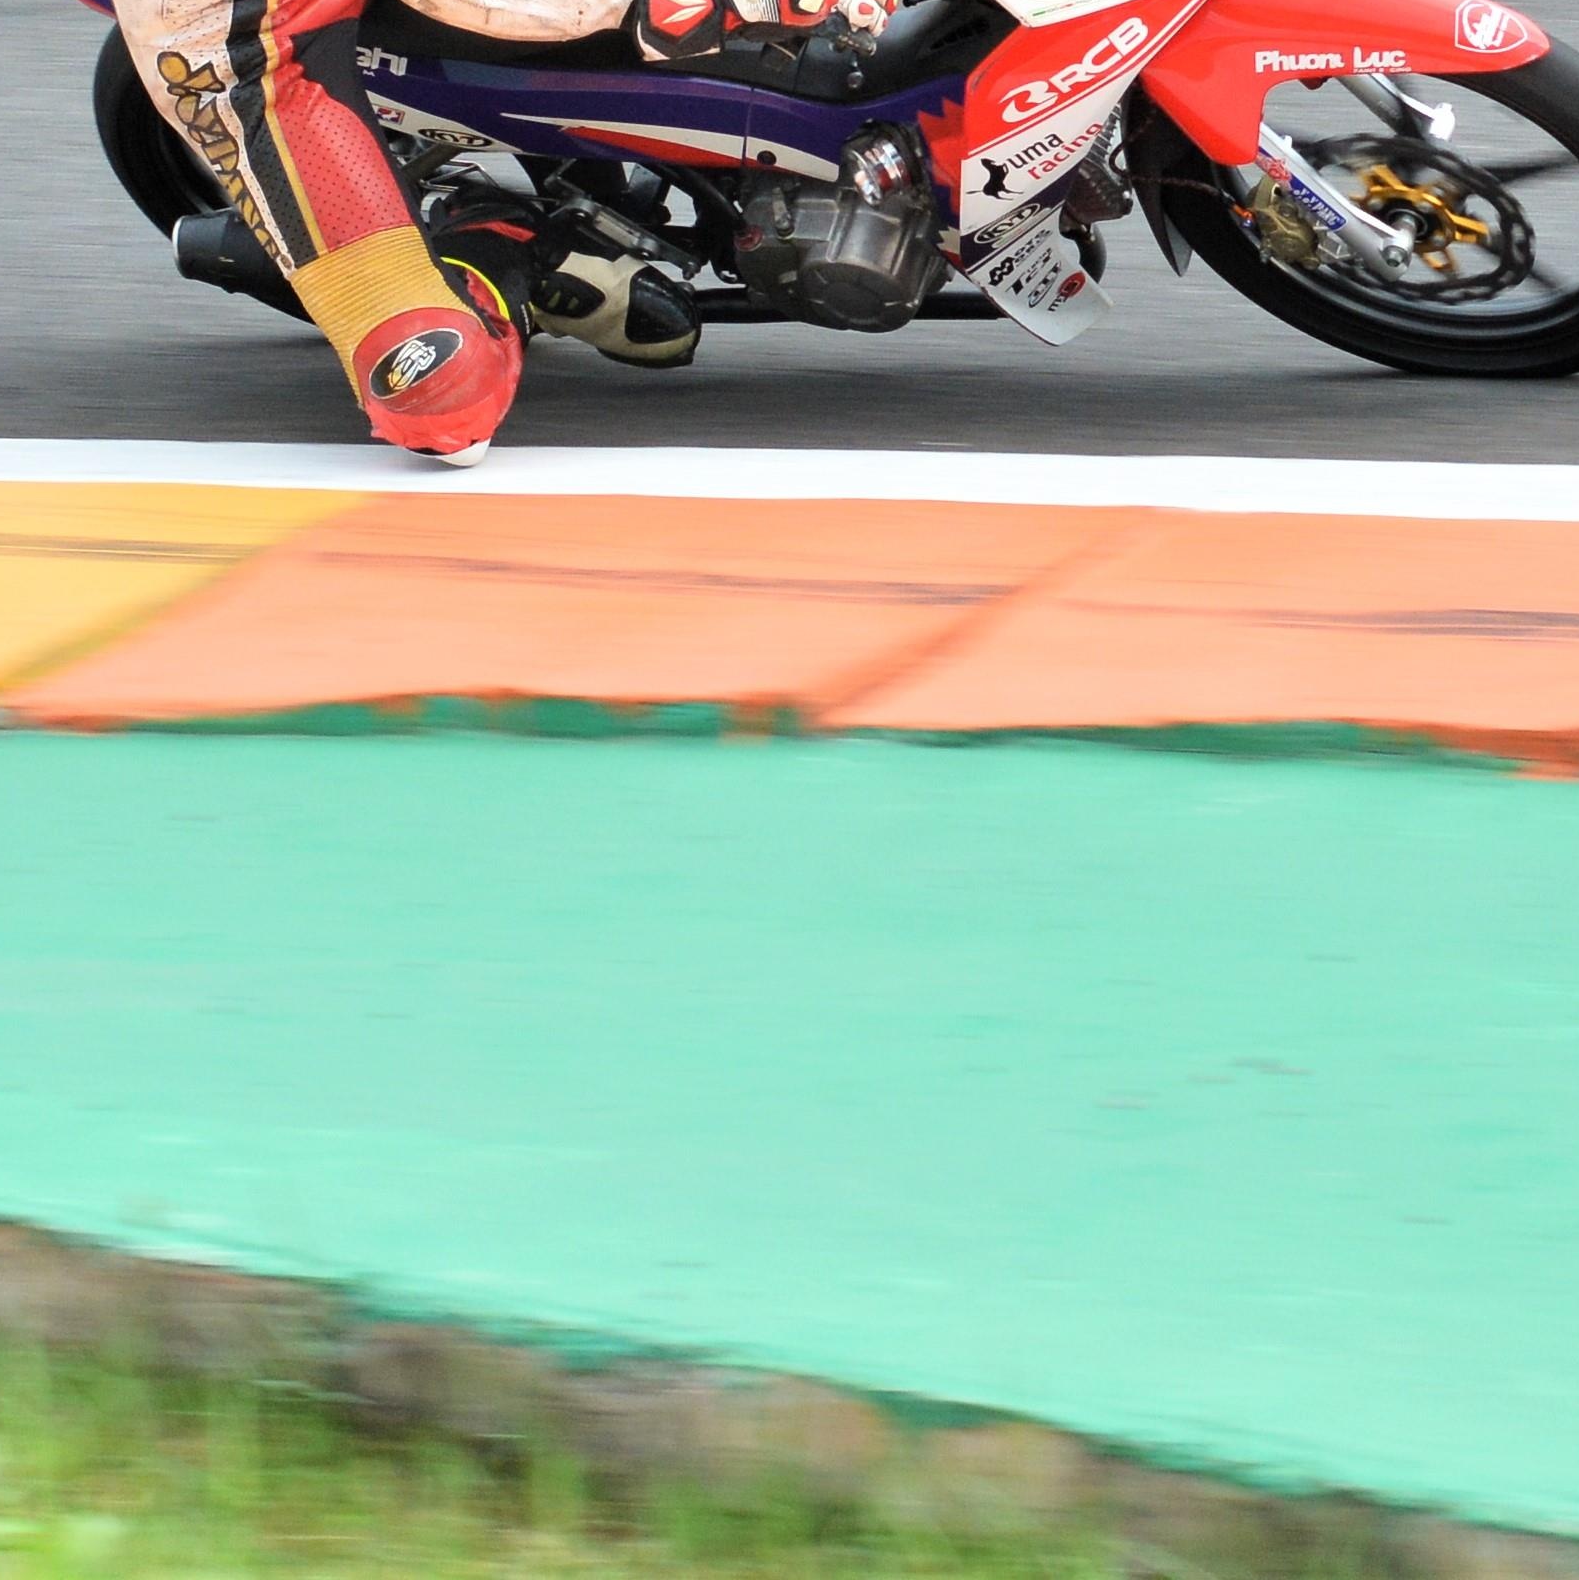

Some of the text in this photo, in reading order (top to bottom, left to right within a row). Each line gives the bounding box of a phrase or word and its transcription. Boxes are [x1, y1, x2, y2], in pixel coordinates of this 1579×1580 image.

[1352, 46, 1406, 68] Luc
[424, 129, 477, 145] KYT
[1027, 120, 1104, 181] racing
